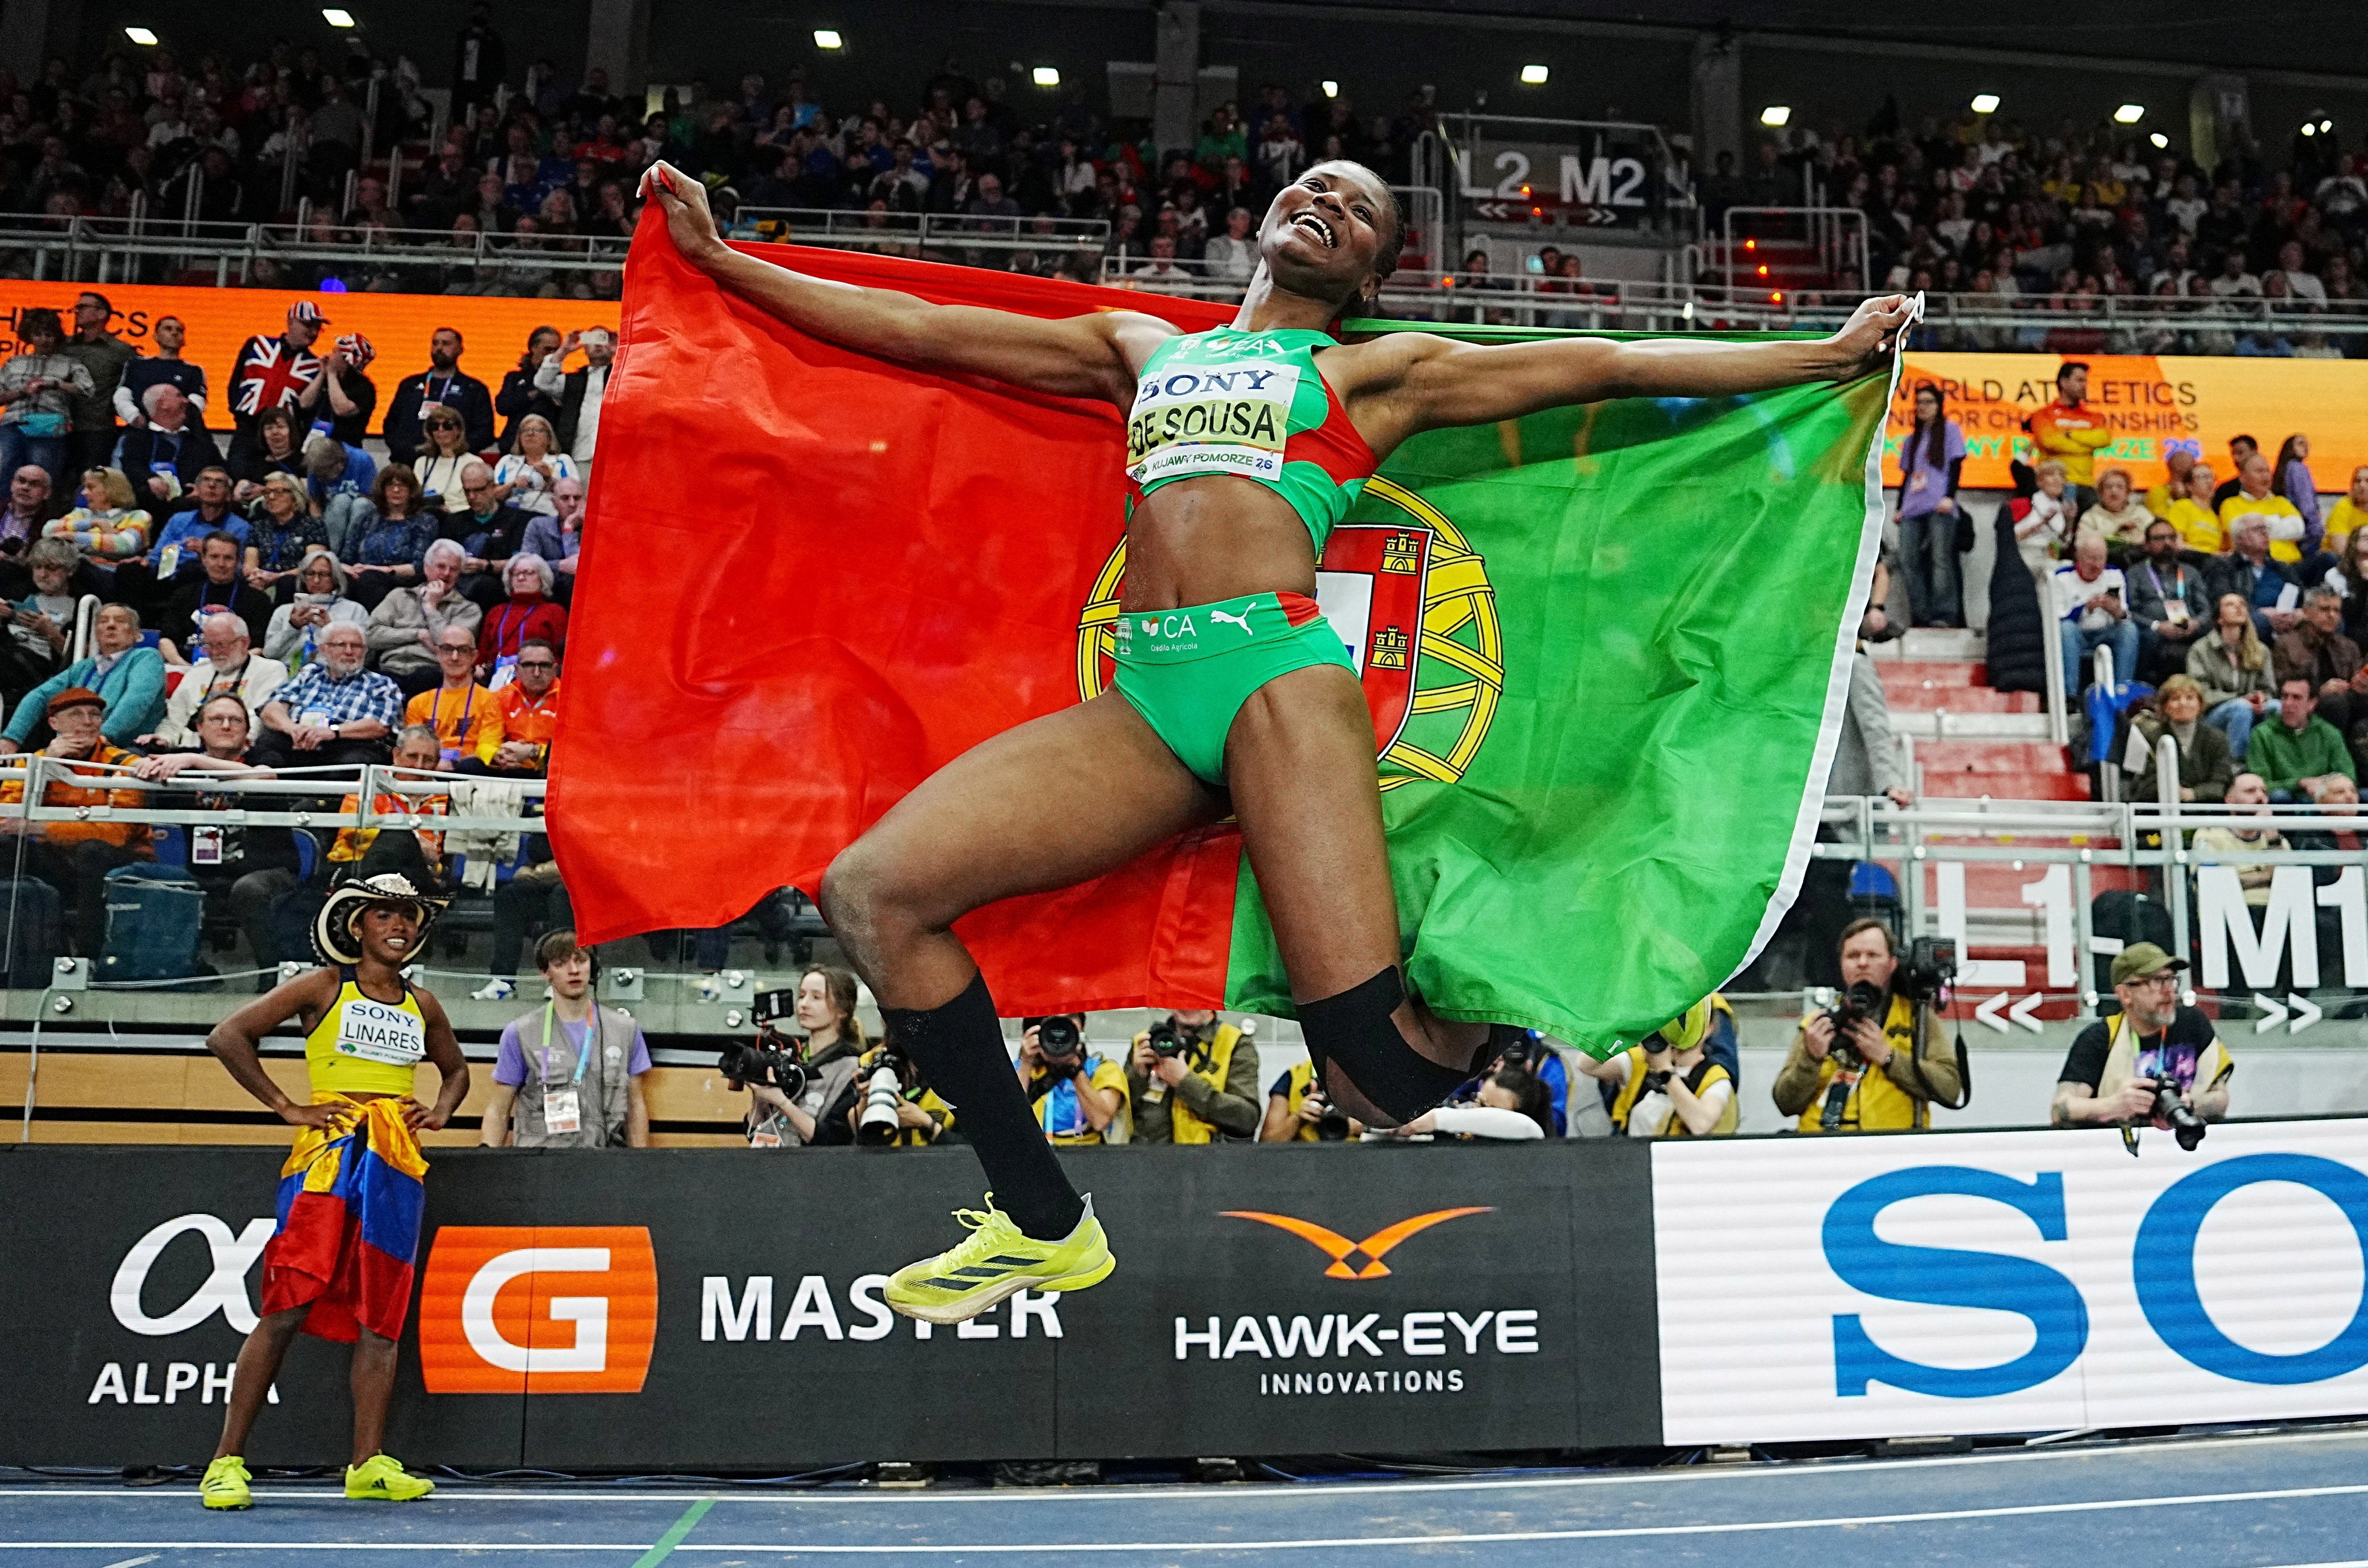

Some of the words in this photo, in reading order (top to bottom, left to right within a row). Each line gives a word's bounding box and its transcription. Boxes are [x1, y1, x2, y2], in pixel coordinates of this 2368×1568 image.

[1458, 149, 1531, 201] L2
[1559, 155, 1645, 206] M2
[1138, 370, 1274, 404] SONY
[2016, 380, 2197, 405] ATETICS
[1132, 411, 1159, 457] DE
[1162, 402, 1275, 442] SOUSA
[1988, 410, 2198, 432] CHNSHIPS
[1152, 455, 1192, 472] KUJAWY
[1193, 453, 1253, 466] POMORZE
[1256, 457, 1273, 470] 26
[1884, 435, 2004, 459] KWY
[2012, 436, 2156, 461] PRZE
[1164, 615, 1197, 638] CA
[1936, 861, 2078, 989] L1
[2198, 865, 2368, 989] M1
[351, 1003, 415, 1027] SONY
[345, 1021, 419, 1051] LINARES
[1822, 1152, 2368, 1399] SO
[462, 1247, 611, 1372] G
[700, 1274, 1064, 1342] MASR
[1175, 1310, 1539, 1360] HAWK-EYE
[88, 1363, 280, 1405] ALPH
[1261, 1369, 1464, 1395] INNOVATIONS
